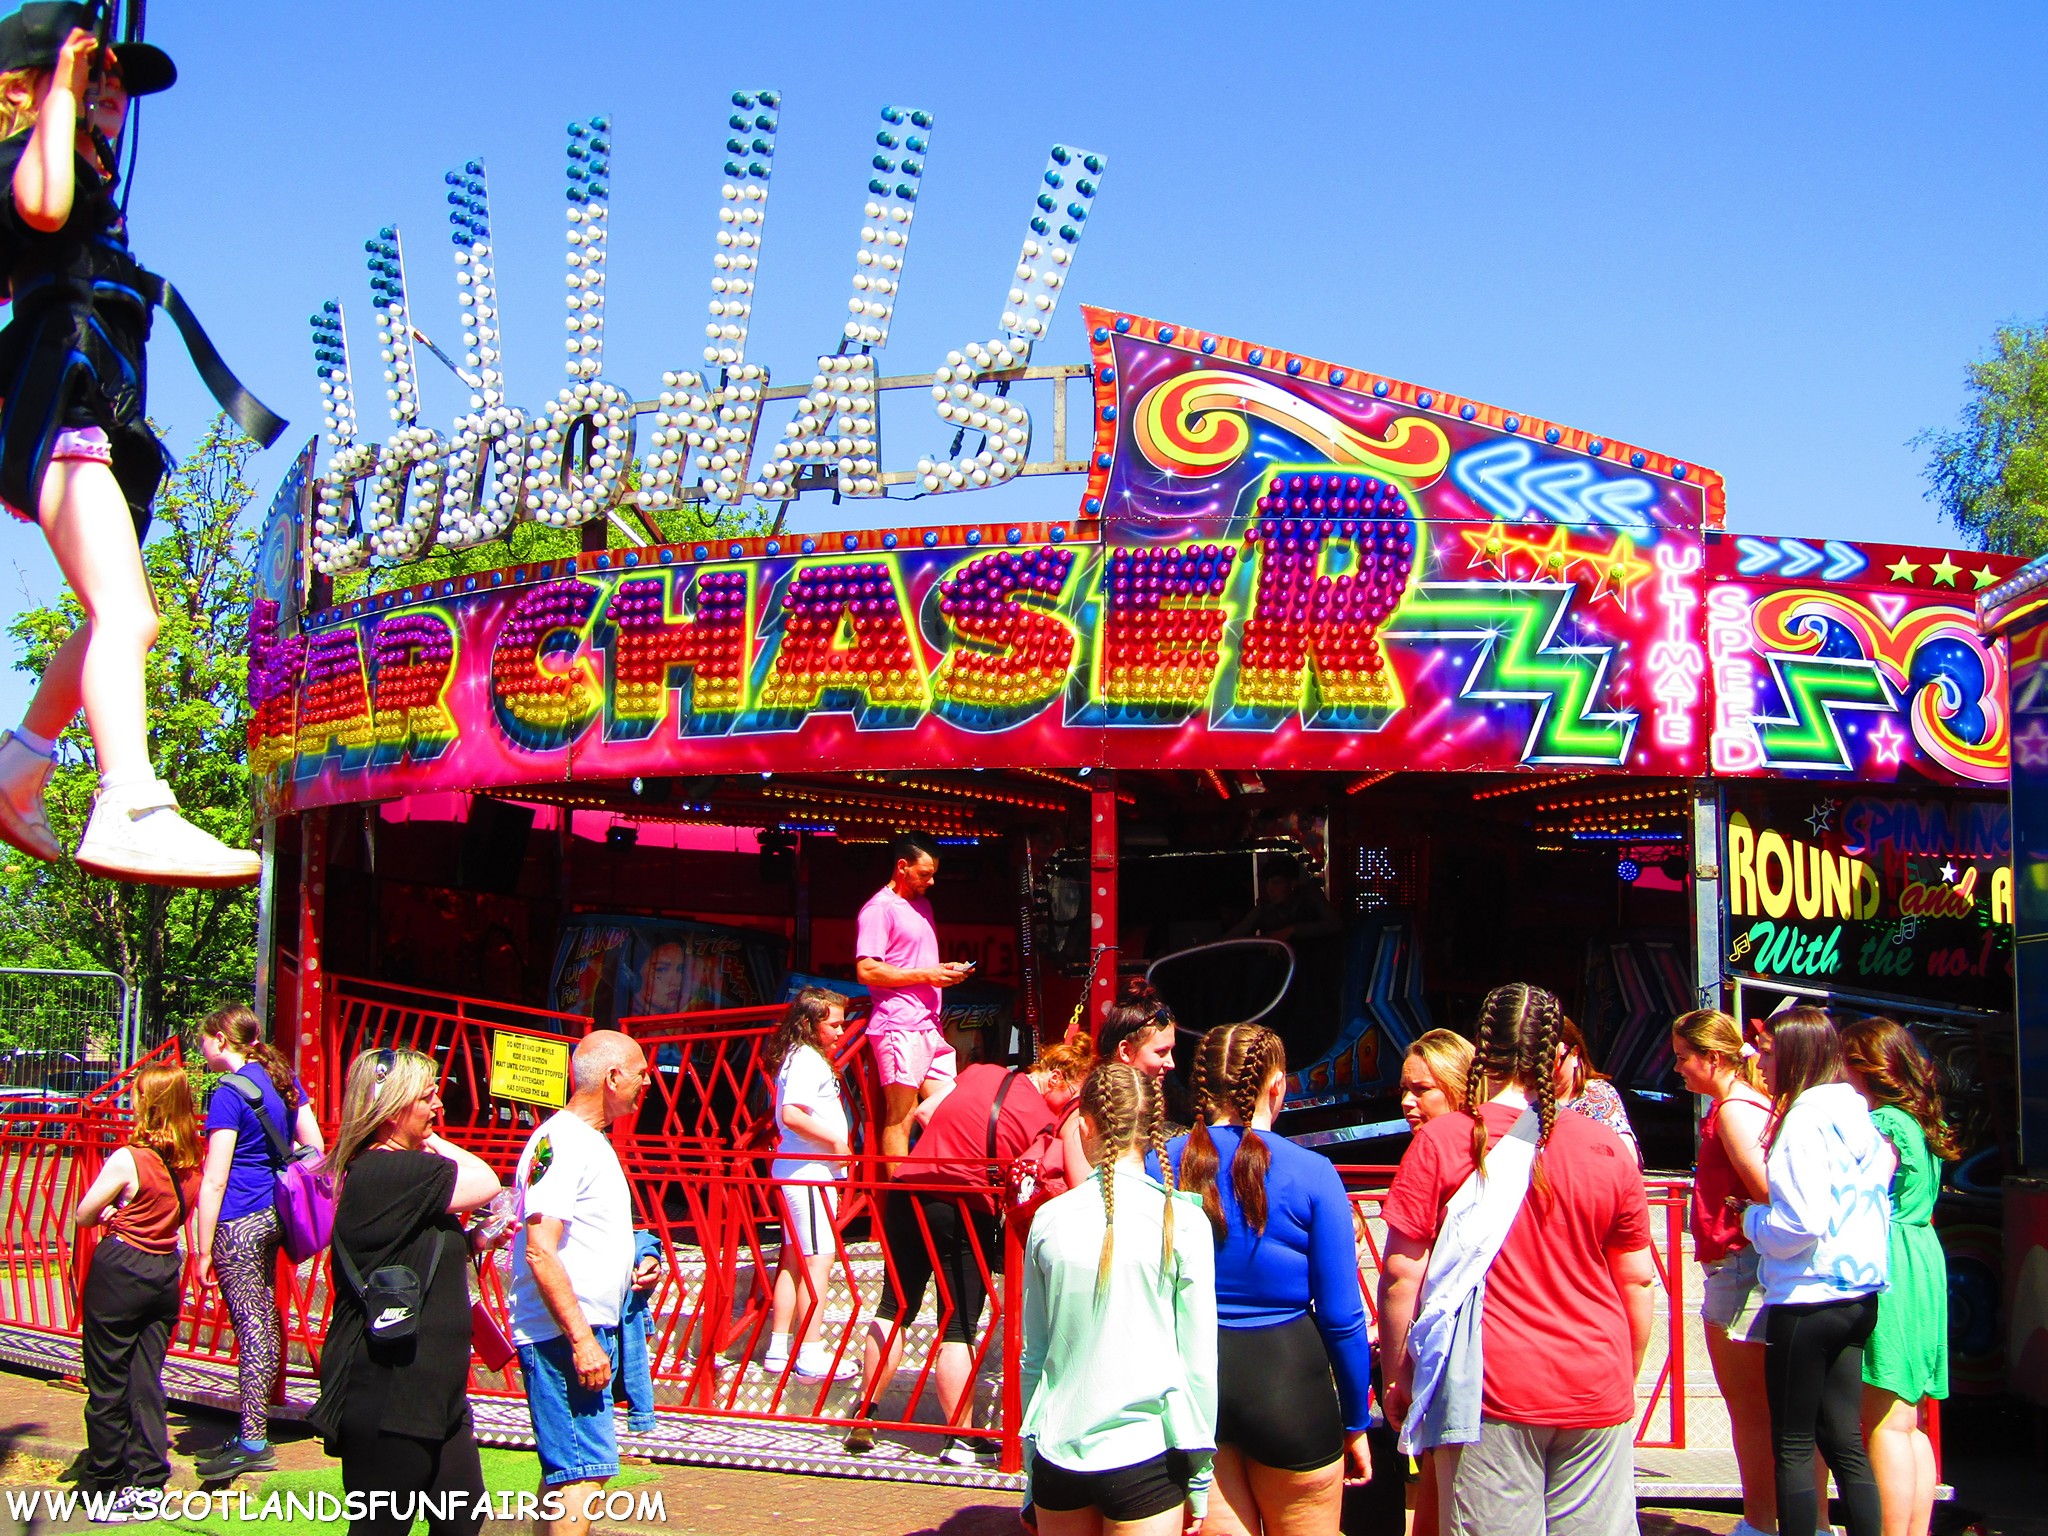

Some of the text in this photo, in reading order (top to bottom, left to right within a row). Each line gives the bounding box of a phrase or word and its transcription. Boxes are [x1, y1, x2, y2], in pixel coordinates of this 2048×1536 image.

[311, 335, 1032, 576] CODONAS
[493, 467, 1425, 750] CHASER
[1647, 544, 1703, 745] ULTIMATE
[1708, 586, 1760, 772] SPEED
[1728, 810, 1881, 921] ROUND
[1899, 866, 1978, 919] and
[1749, 919, 1843, 976] With
[1858, 928, 1915, 976] the
[506, 1062, 518, 1070] UNTIL
[519, 1064, 544, 1075] COMPLETELY
[544, 1068, 563, 1079] STOPPED
[380, 1307, 409, 1320] NIKE
